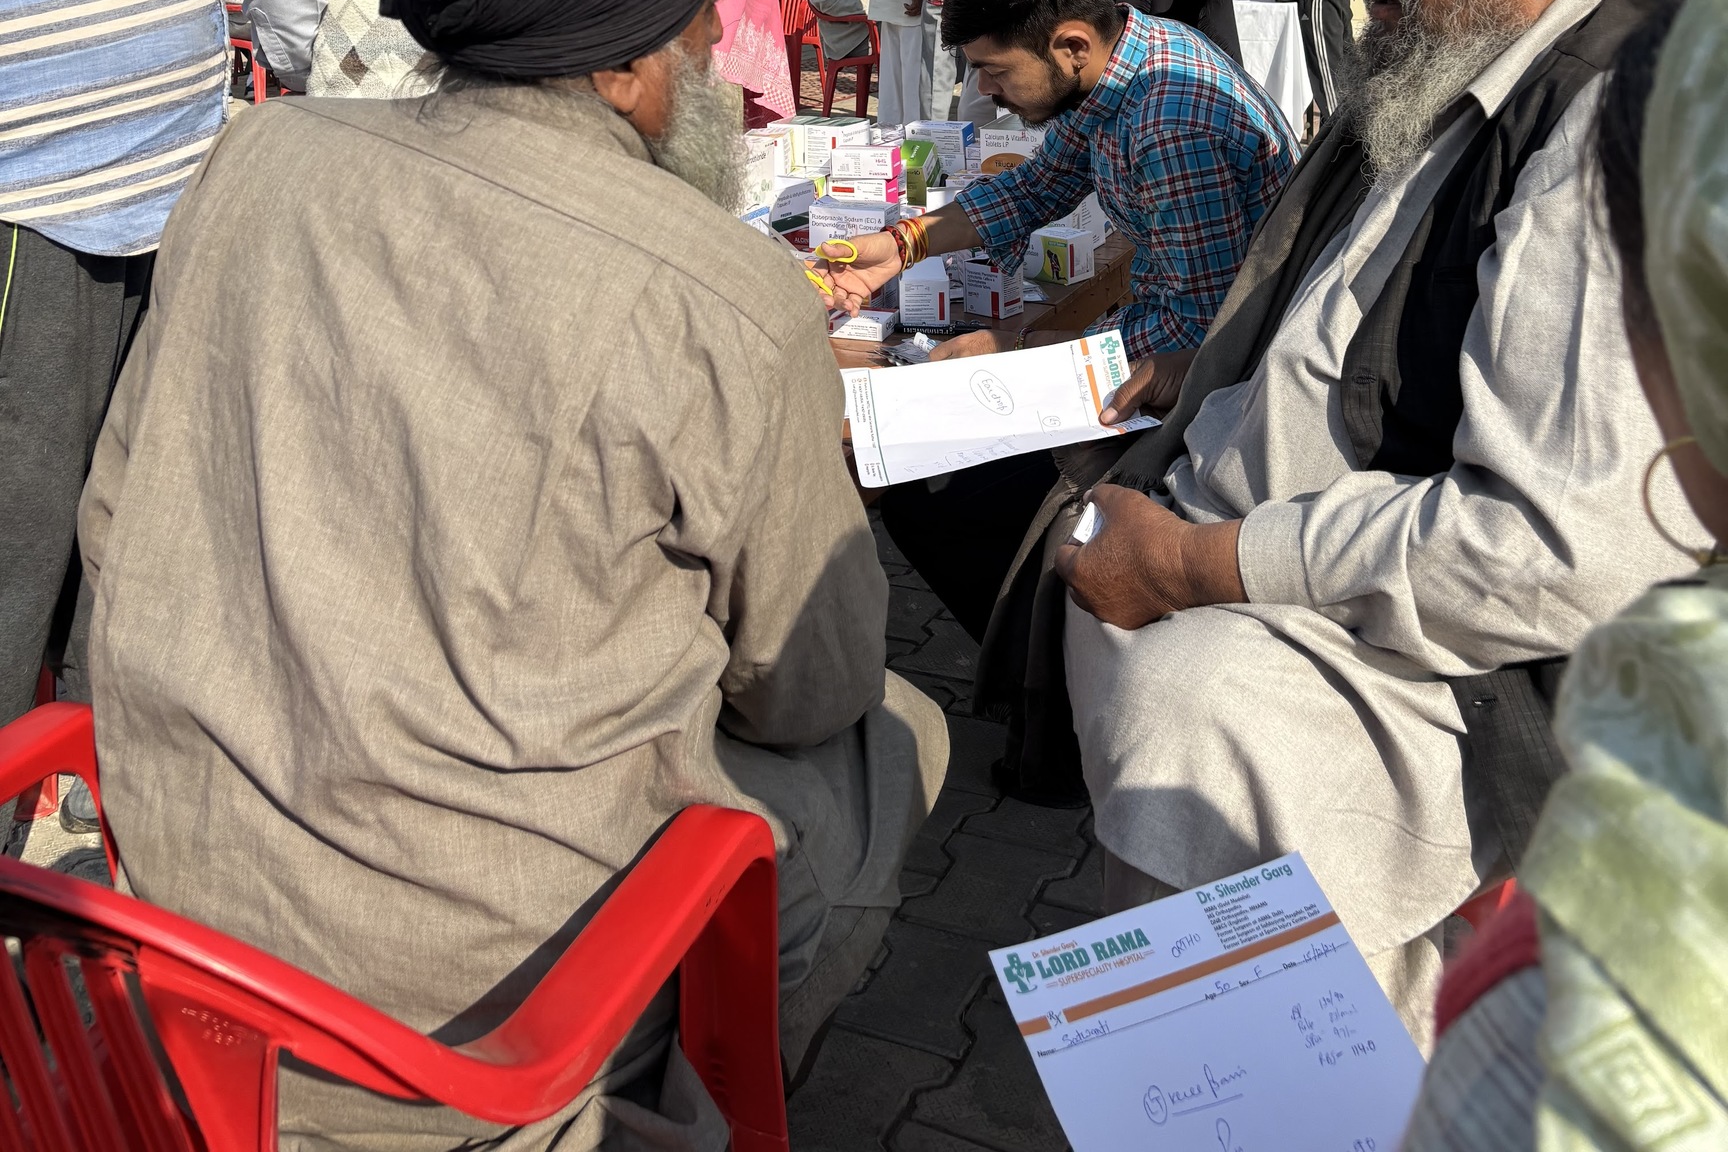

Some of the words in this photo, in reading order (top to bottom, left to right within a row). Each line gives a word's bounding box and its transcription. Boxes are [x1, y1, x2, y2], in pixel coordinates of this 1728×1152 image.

[984, 133, 1005, 141] Calcium
[844, 215, 864, 223] Sodium
[1107, 356, 1122, 387] LORD
[1195, 889, 1215, 904] Dr.
[1215, 875, 1260, 896] Sitender
[1261, 863, 1293, 881] Garg
[1035, 947, 1091, 979] LORD
[1090, 928, 1151, 962] RAMA
[1253, 965, 1263, 979] F
[1282, 960, 1297, 970] Date
[1058, 961, 1113, 987] SUPERSPECIALITY
[1214, 980, 1231, 995] 50
[1238, 979, 1250, 988] Sex
[1204, 992, 1217, 1002] Age
